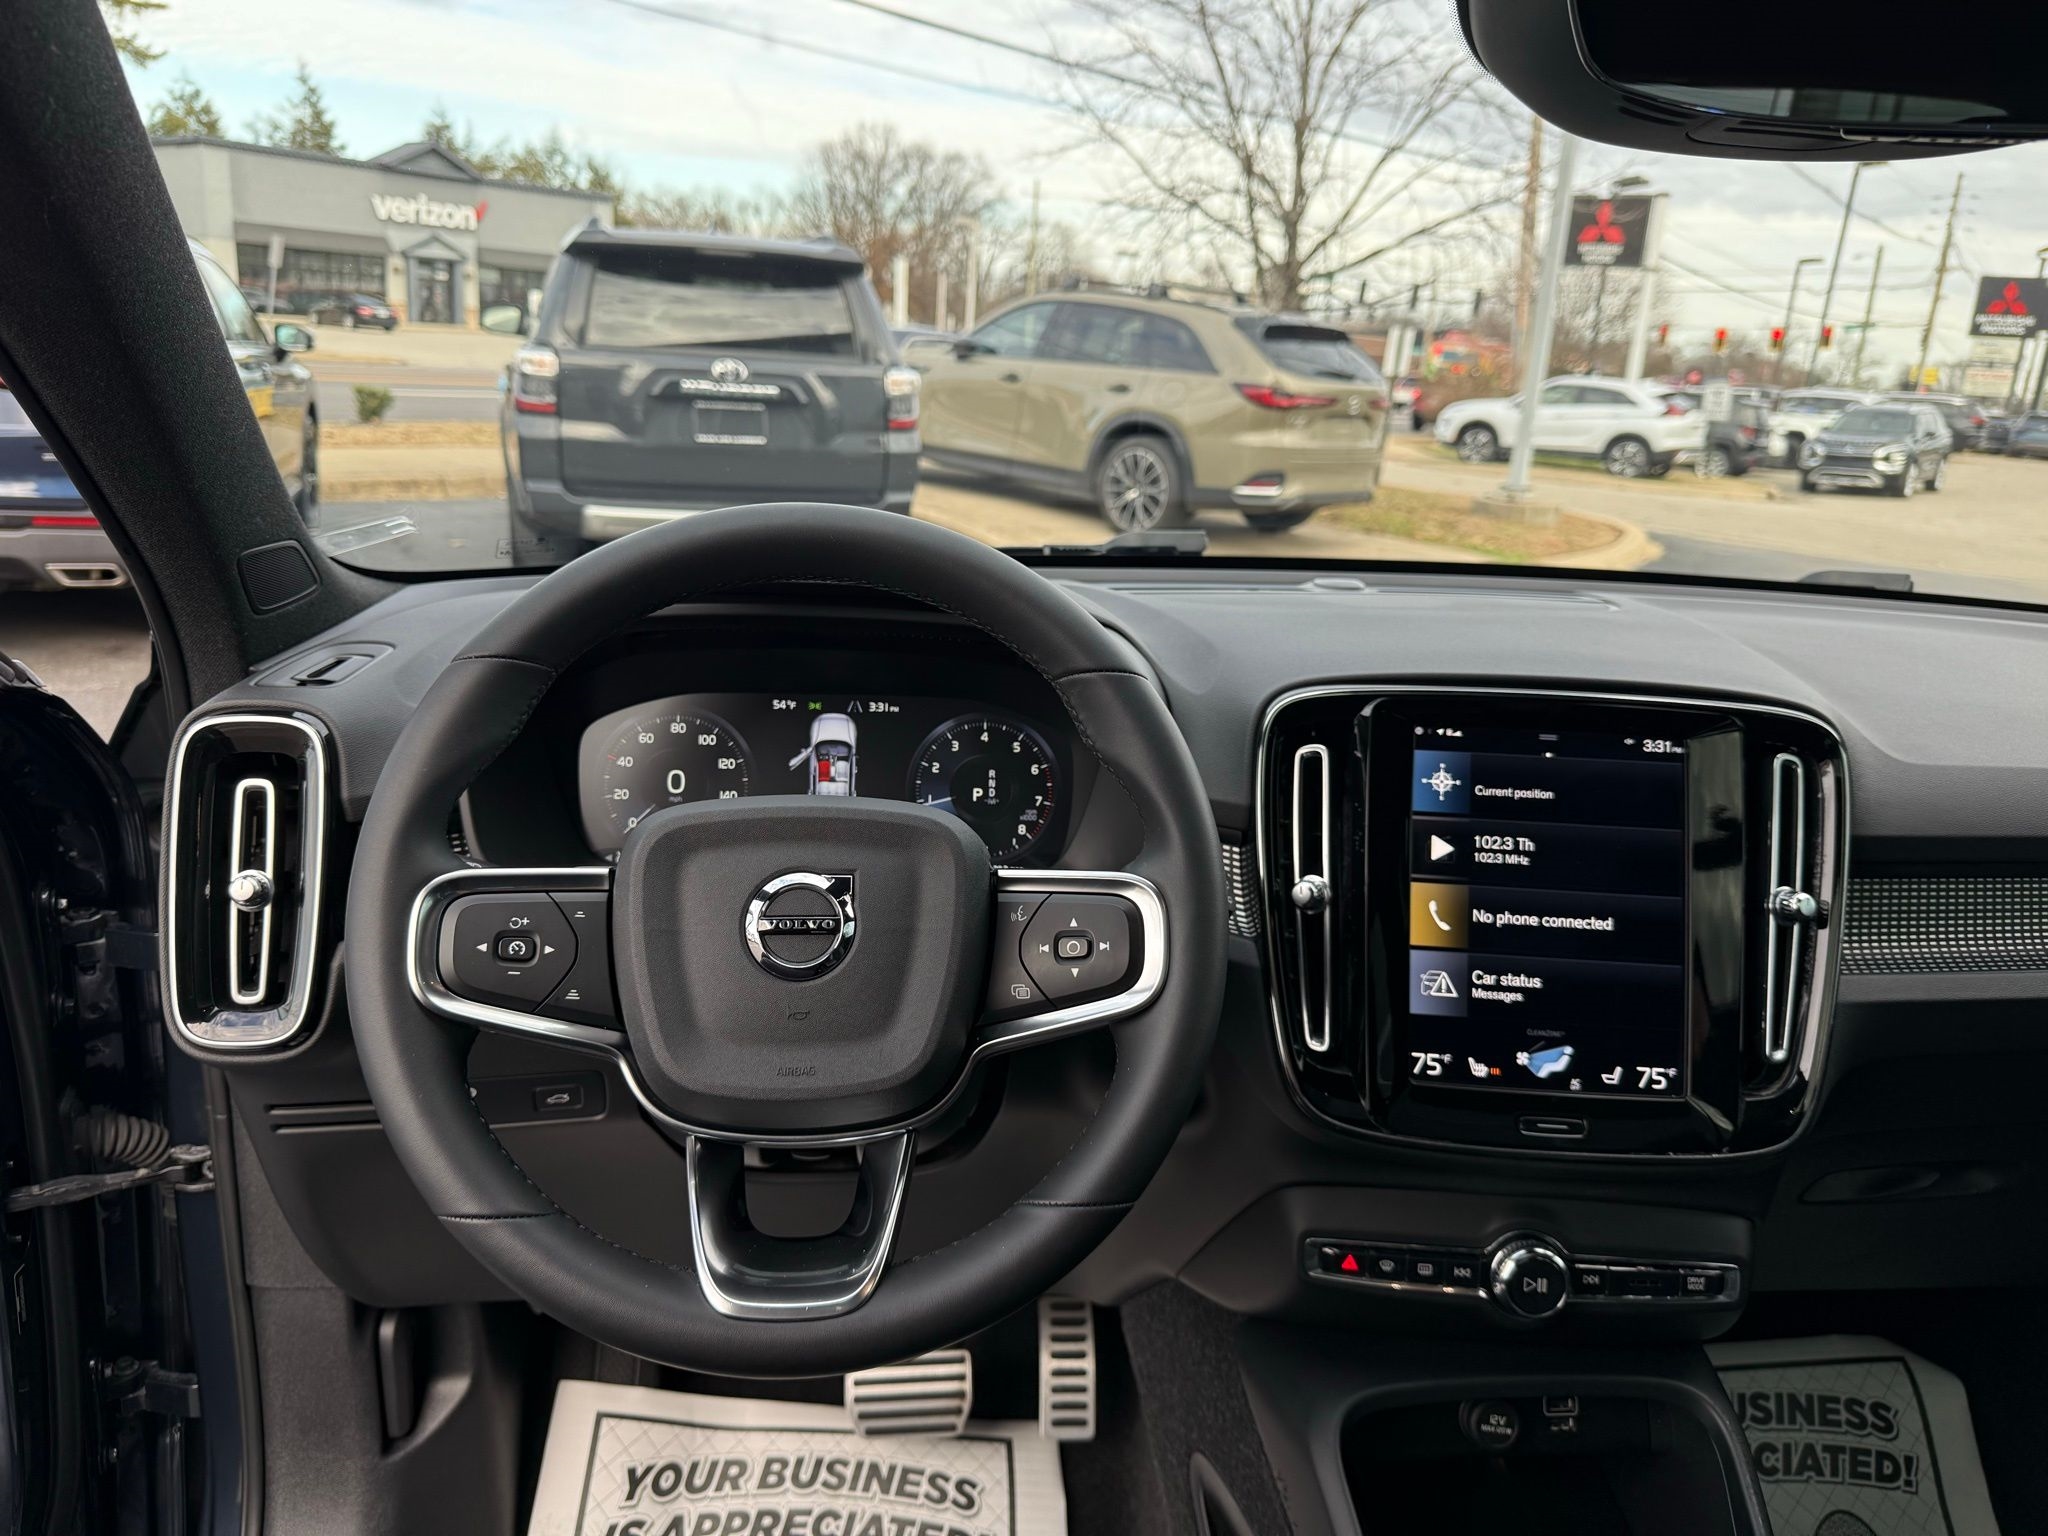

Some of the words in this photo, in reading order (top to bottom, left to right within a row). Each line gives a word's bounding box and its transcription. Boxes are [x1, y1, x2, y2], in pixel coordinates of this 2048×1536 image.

[370, 193, 478, 231] verizon
[772, 699, 797, 710] 54°F
[868, 702, 889, 712] 3:31
[670, 723, 687, 734] 80
[638, 733, 655, 744] 60
[698, 735, 717, 746] 100
[980, 732, 989, 743] 4
[951, 740, 959, 751] 3
[1012, 742, 1021, 753] 5
[1642, 739, 1672, 753] 3:31
[616, 756, 634, 767] 40
[718, 758, 736, 769] 120
[931, 762, 940, 773] 2
[1030, 764, 1039, 775] 6
[988, 769, 996, 778] R
[666, 769, 686, 794] 0
[988, 779, 996, 787] N
[613, 789, 630, 800] 20
[719, 790, 738, 799] 140
[972, 788, 984, 801] P
[988, 788, 996, 797] D
[1475, 784, 1514, 797] Current
[1514, 788, 1556, 800] position
[1034, 795, 1043, 807] 7
[628, 818, 637, 828] 0
[1017, 824, 1026, 835] 8
[1474, 835, 1515, 850] 102.3
[1516, 837, 1536, 851] Th
[1474, 852, 1504, 864] 102.3
[1505, 854, 1531, 865] MHz
[765, 919, 836, 929] VOLVO
[1472, 909, 1494, 924] No
[1496, 911, 1541, 928] phone
[1541, 917, 1615, 931] connected
[1471, 970, 1498, 985] Car
[1499, 973, 1544, 989] status
[1471, 988, 1525, 1003] Messages
[1411, 1052, 1453, 1076] 75°F
[776, 1066, 816, 1076] AIRBAG
[1636, 1066, 1678, 1090] 75°F
[1736, 1391, 1896, 1435] SINESS
[624, 1459, 748, 1501] YOUR
[757, 1456, 977, 1511] BUSINESS
